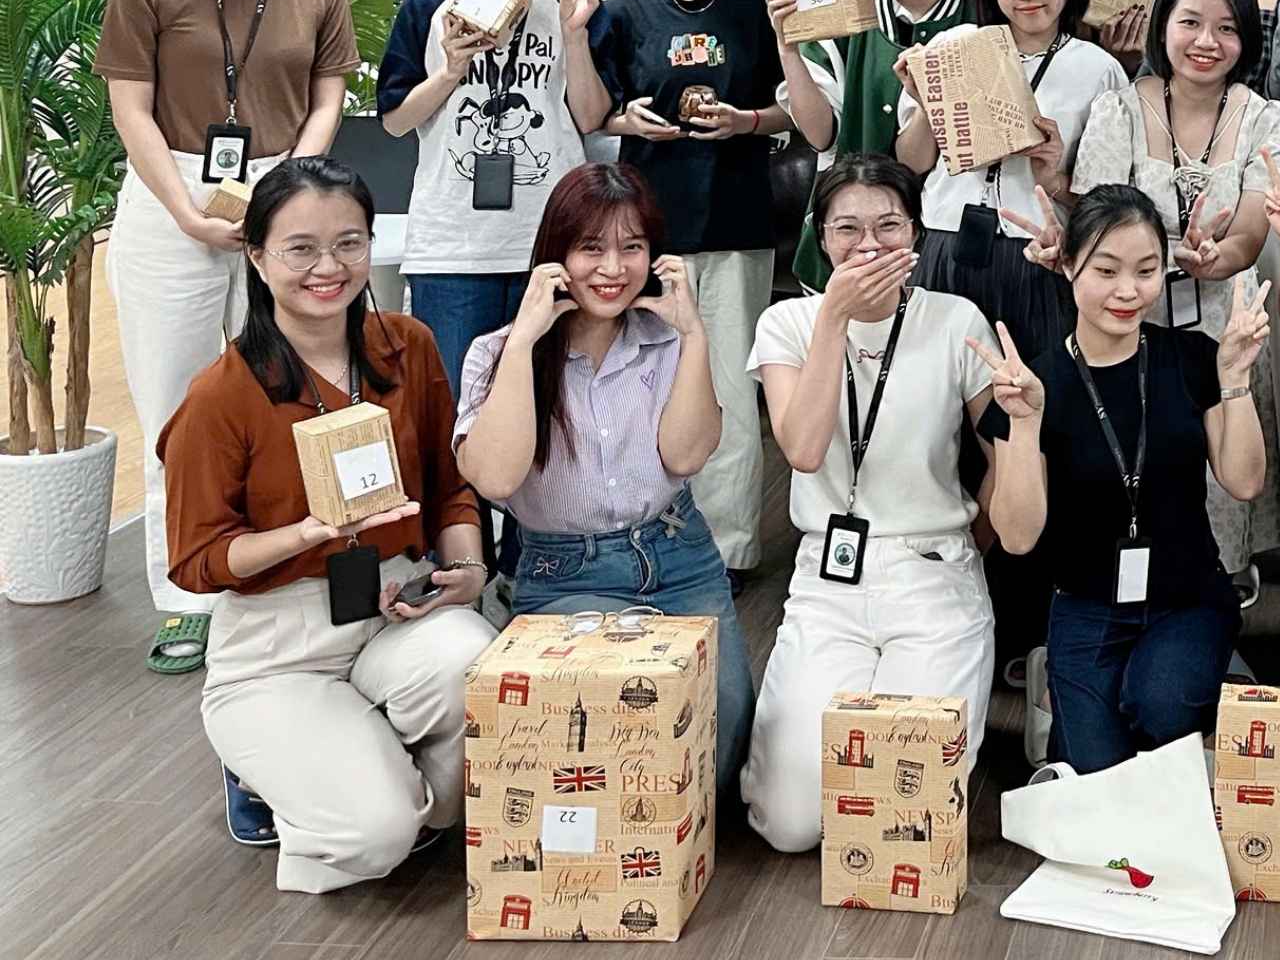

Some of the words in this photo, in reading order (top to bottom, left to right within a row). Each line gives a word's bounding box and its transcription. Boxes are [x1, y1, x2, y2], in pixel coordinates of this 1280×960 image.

[525, 33, 556, 61] Pal,
[925, 50, 943, 103] Easter
[953, 102, 972, 148] battle
[360, 473, 378, 489] 12
[559, 810, 577, 823] 22
